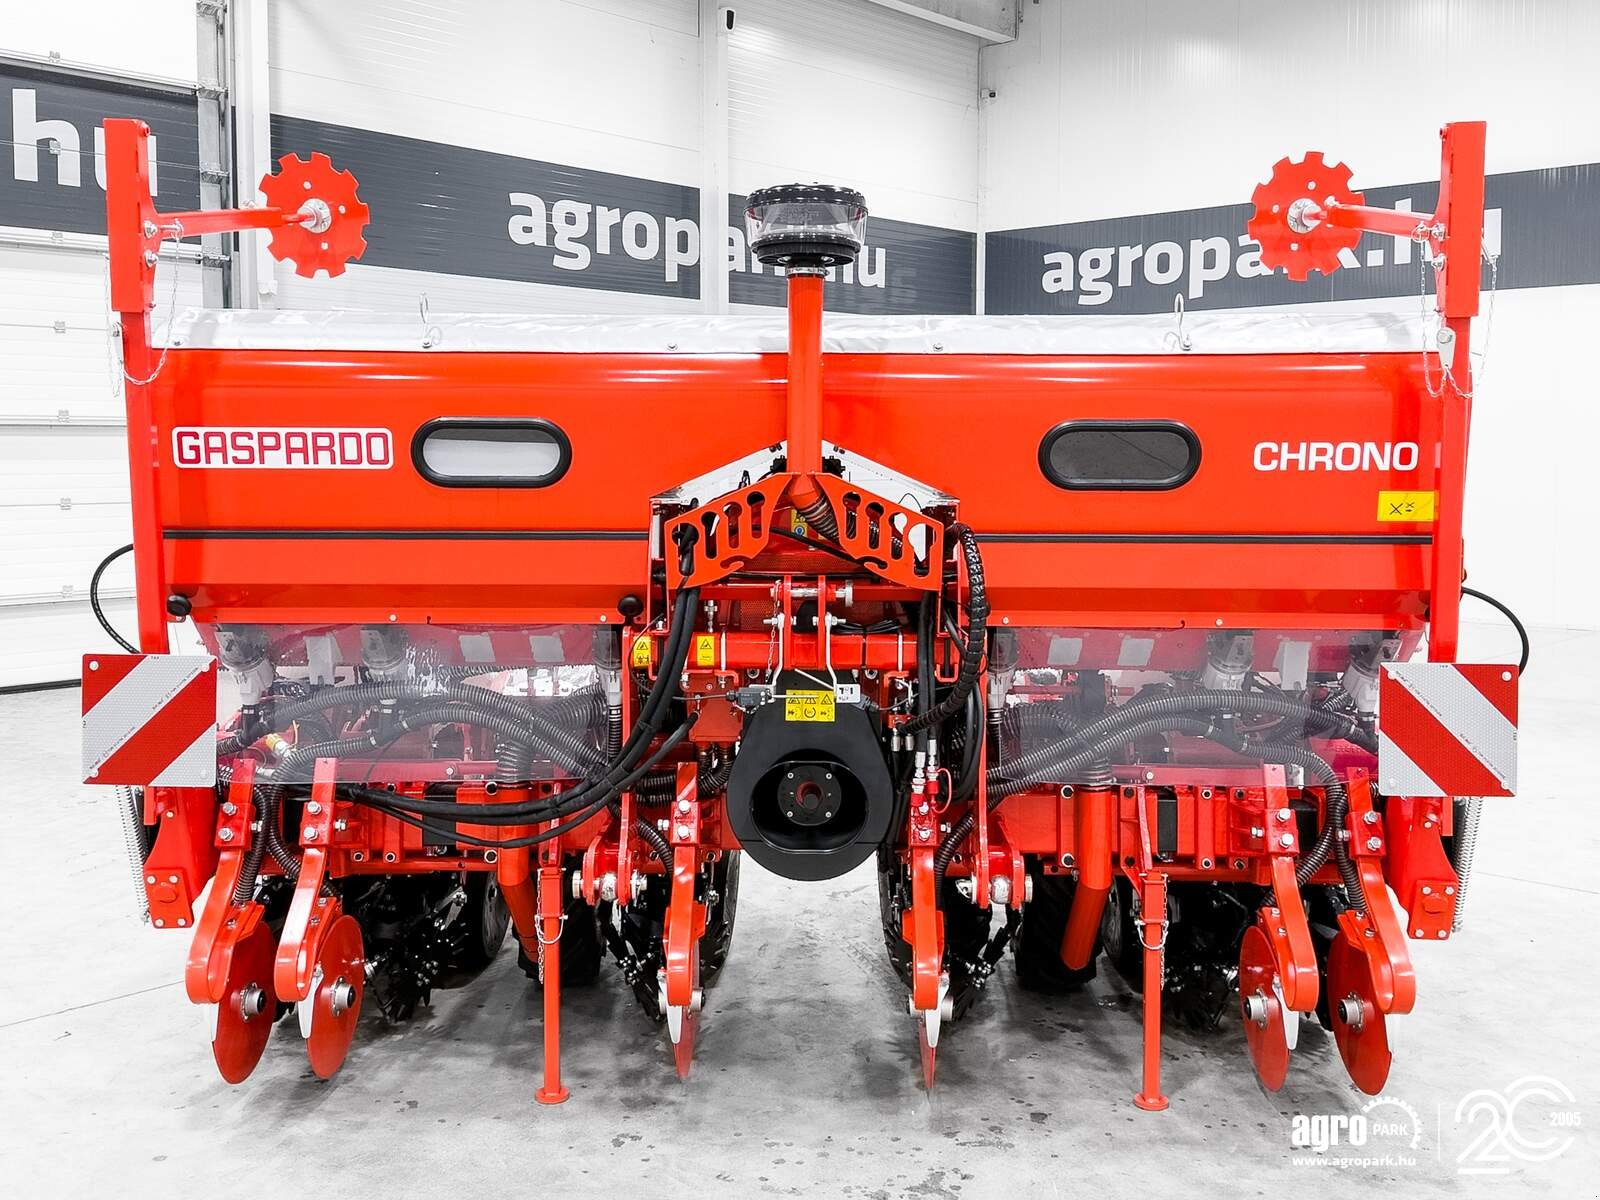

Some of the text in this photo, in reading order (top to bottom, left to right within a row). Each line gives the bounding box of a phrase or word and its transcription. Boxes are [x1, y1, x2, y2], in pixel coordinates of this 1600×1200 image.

[508, 192, 886, 288] agropau
[176, 431, 390, 465] GASPARDO
[1253, 441, 1419, 471] CHRONO
